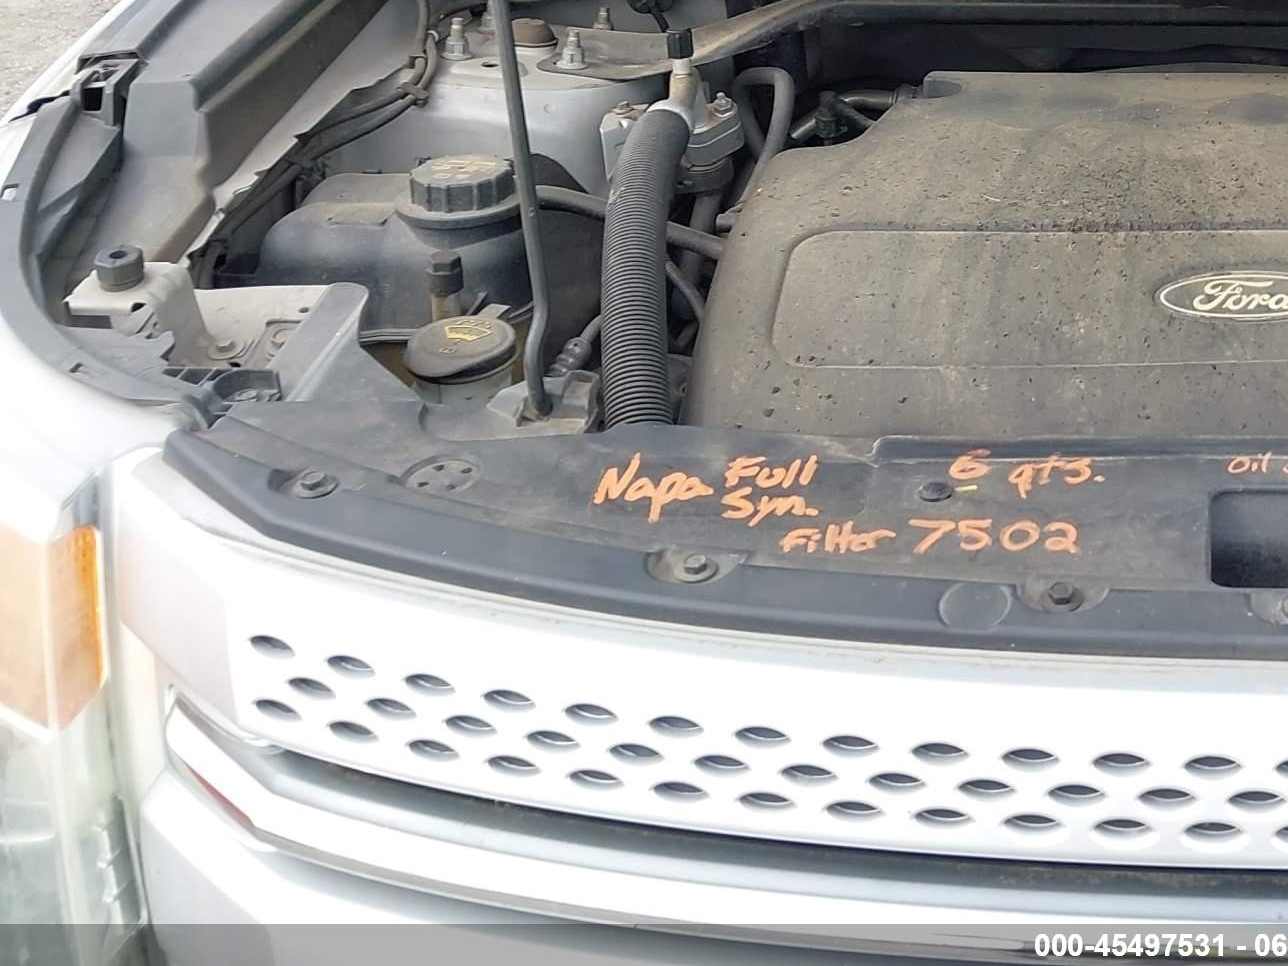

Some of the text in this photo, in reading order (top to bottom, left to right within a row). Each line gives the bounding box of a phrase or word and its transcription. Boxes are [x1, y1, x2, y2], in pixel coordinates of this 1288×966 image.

[592, 451, 715, 524] Napa
[723, 454, 819, 489] Full
[948, 448, 1106, 500] 6 qts.
[908, 518, 1081, 555] 7502
